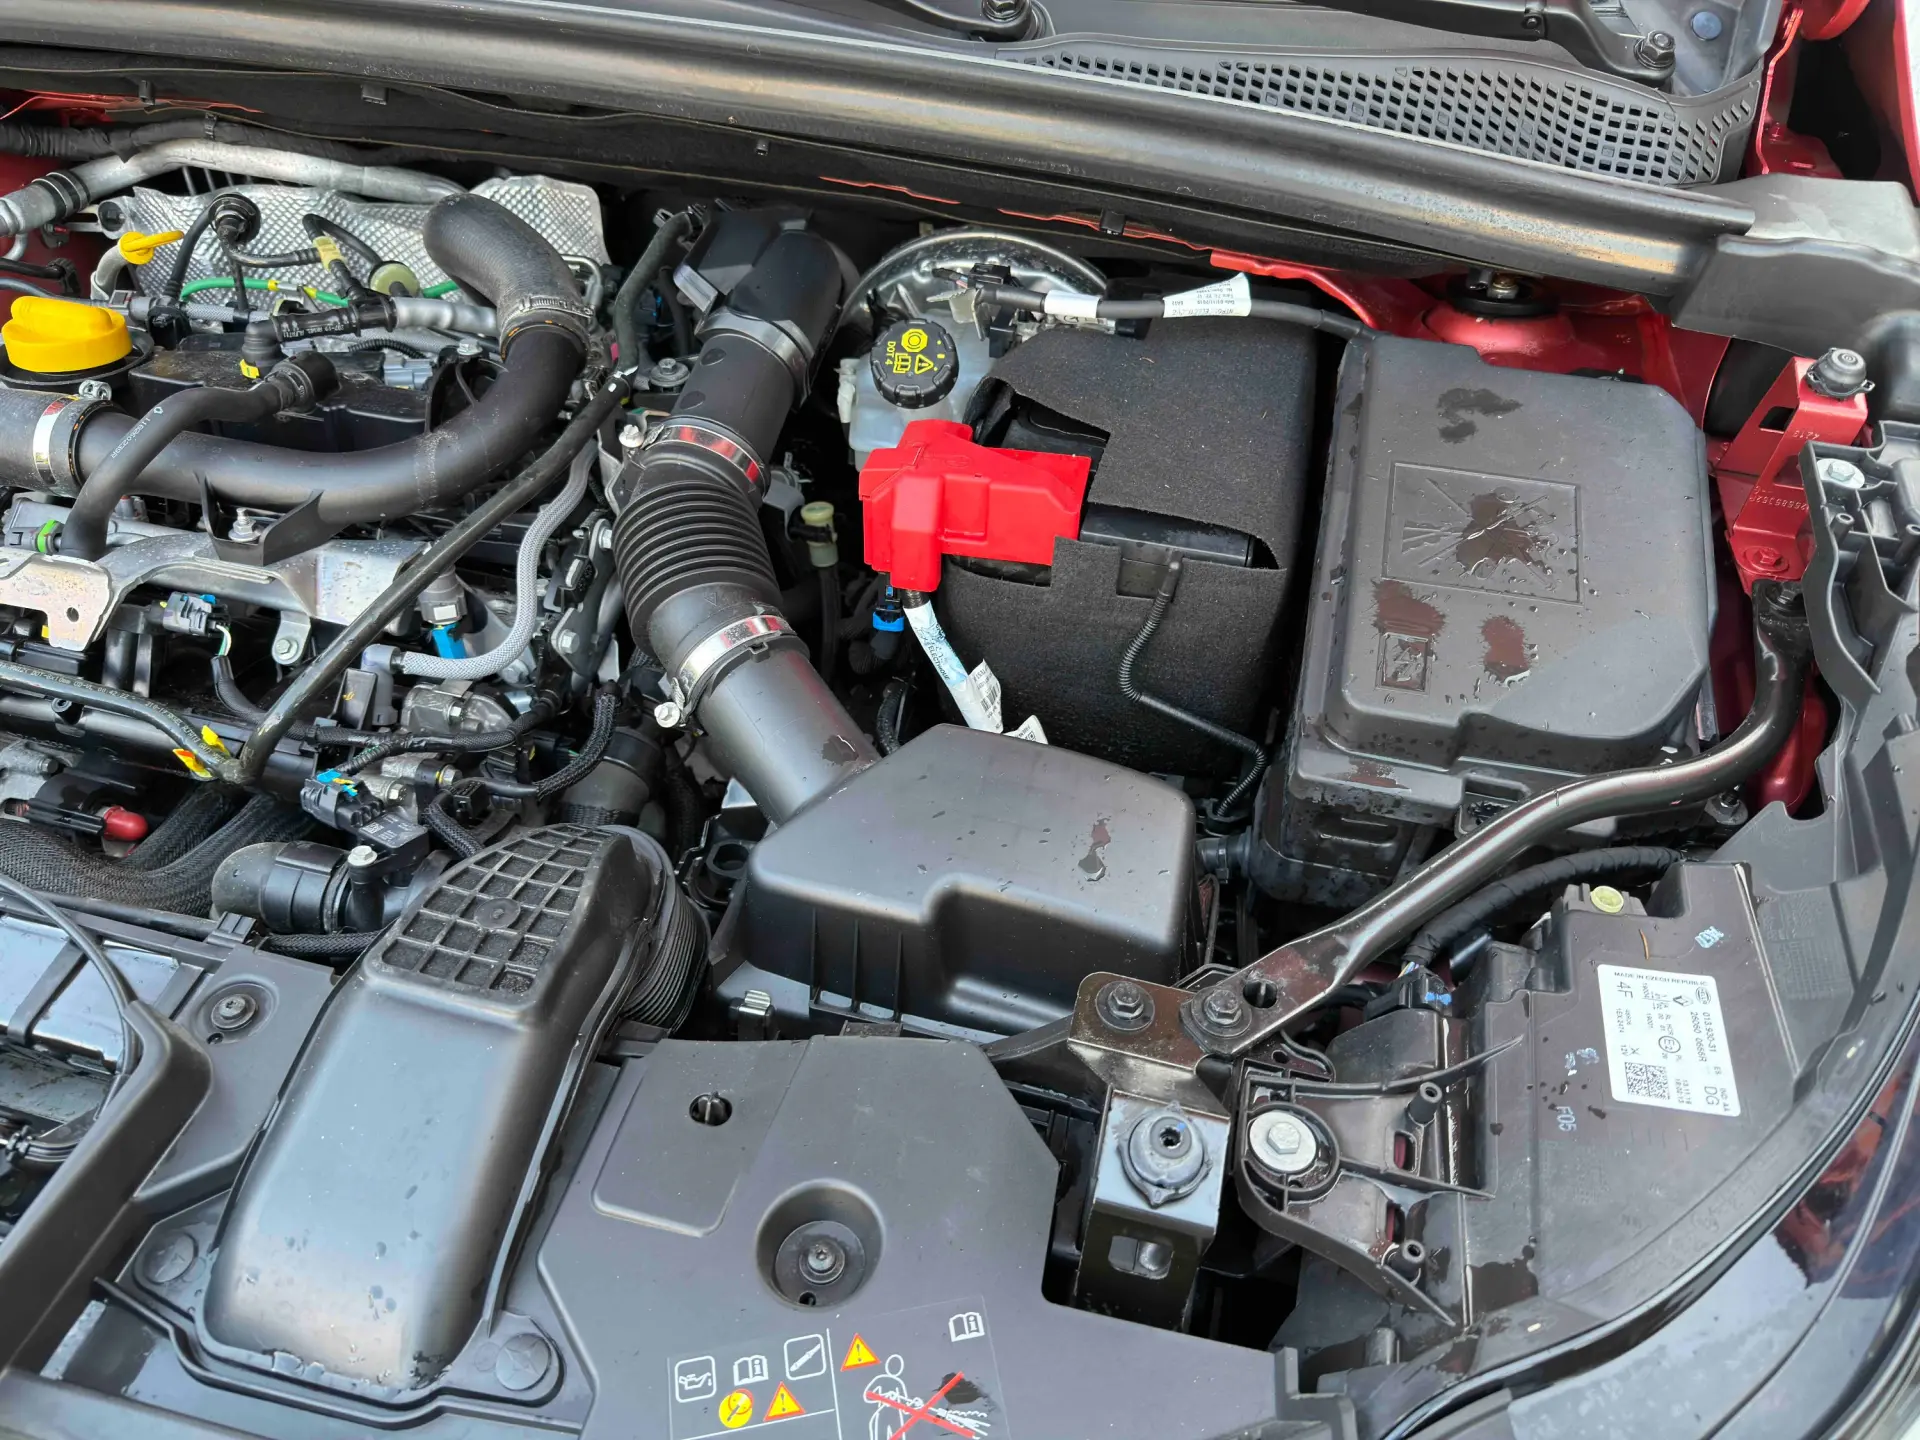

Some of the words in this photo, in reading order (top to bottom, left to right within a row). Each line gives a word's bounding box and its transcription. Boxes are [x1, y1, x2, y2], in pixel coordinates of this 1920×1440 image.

[886, 341, 896, 358] DOT
[1645, 975, 1670, 983] CZECH
[1671, 978, 1708, 986] REPUBLIC
[1616, 981, 1633, 999] 4F
[1704, 1086, 1720, 1106] DG
[1556, 1106, 1577, 1132] F05
